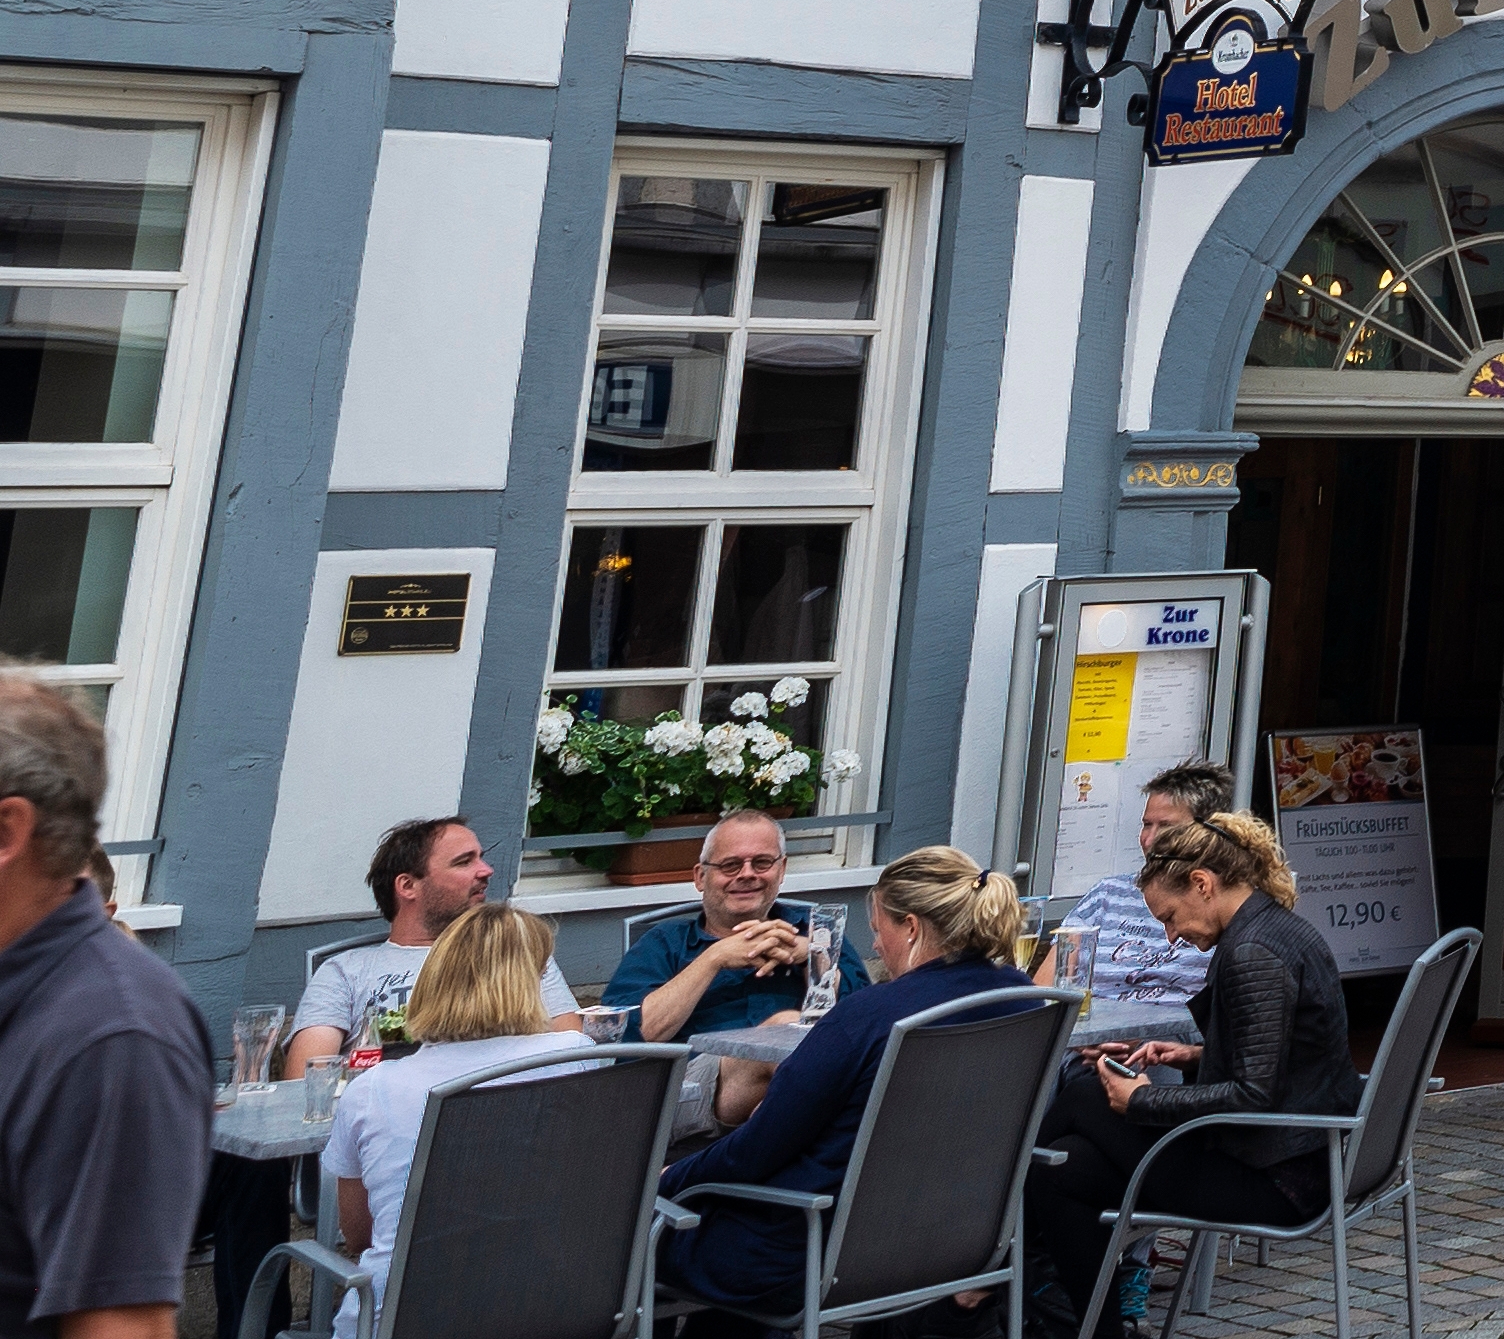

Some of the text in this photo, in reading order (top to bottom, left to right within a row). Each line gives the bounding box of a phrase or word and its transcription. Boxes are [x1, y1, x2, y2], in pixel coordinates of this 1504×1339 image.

[1194, 71, 1258, 114] Hotel
[1162, 106, 1284, 147] Restaurant
[1162, 605, 1199, 624] Zur
[1146, 627, 1210, 646] Krone
[1296, 816, 1410, 838] FRÜHSTÜCKSBUFFET
[1325, 900, 1402, 930] 12,90 €
